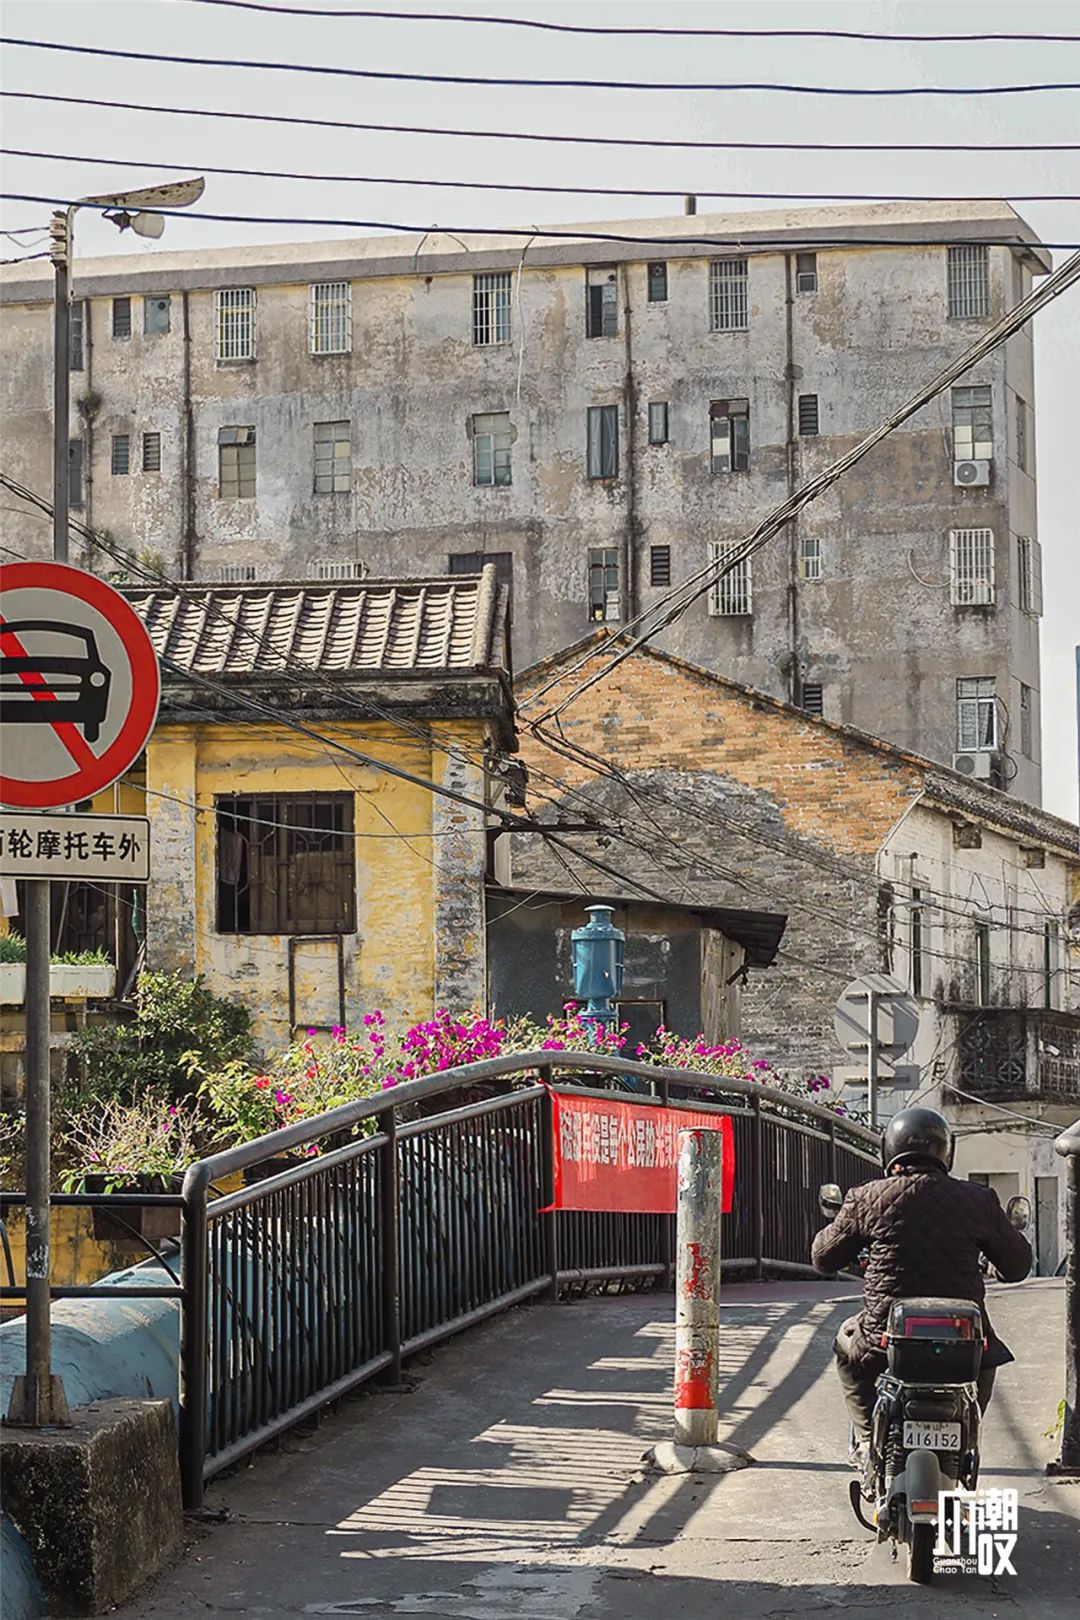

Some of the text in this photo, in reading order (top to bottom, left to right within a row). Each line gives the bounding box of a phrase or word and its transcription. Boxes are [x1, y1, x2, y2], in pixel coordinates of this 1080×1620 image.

[0, 829, 140, 862] 轮摩托车外
[906, 1433, 958, 1447] 416152
